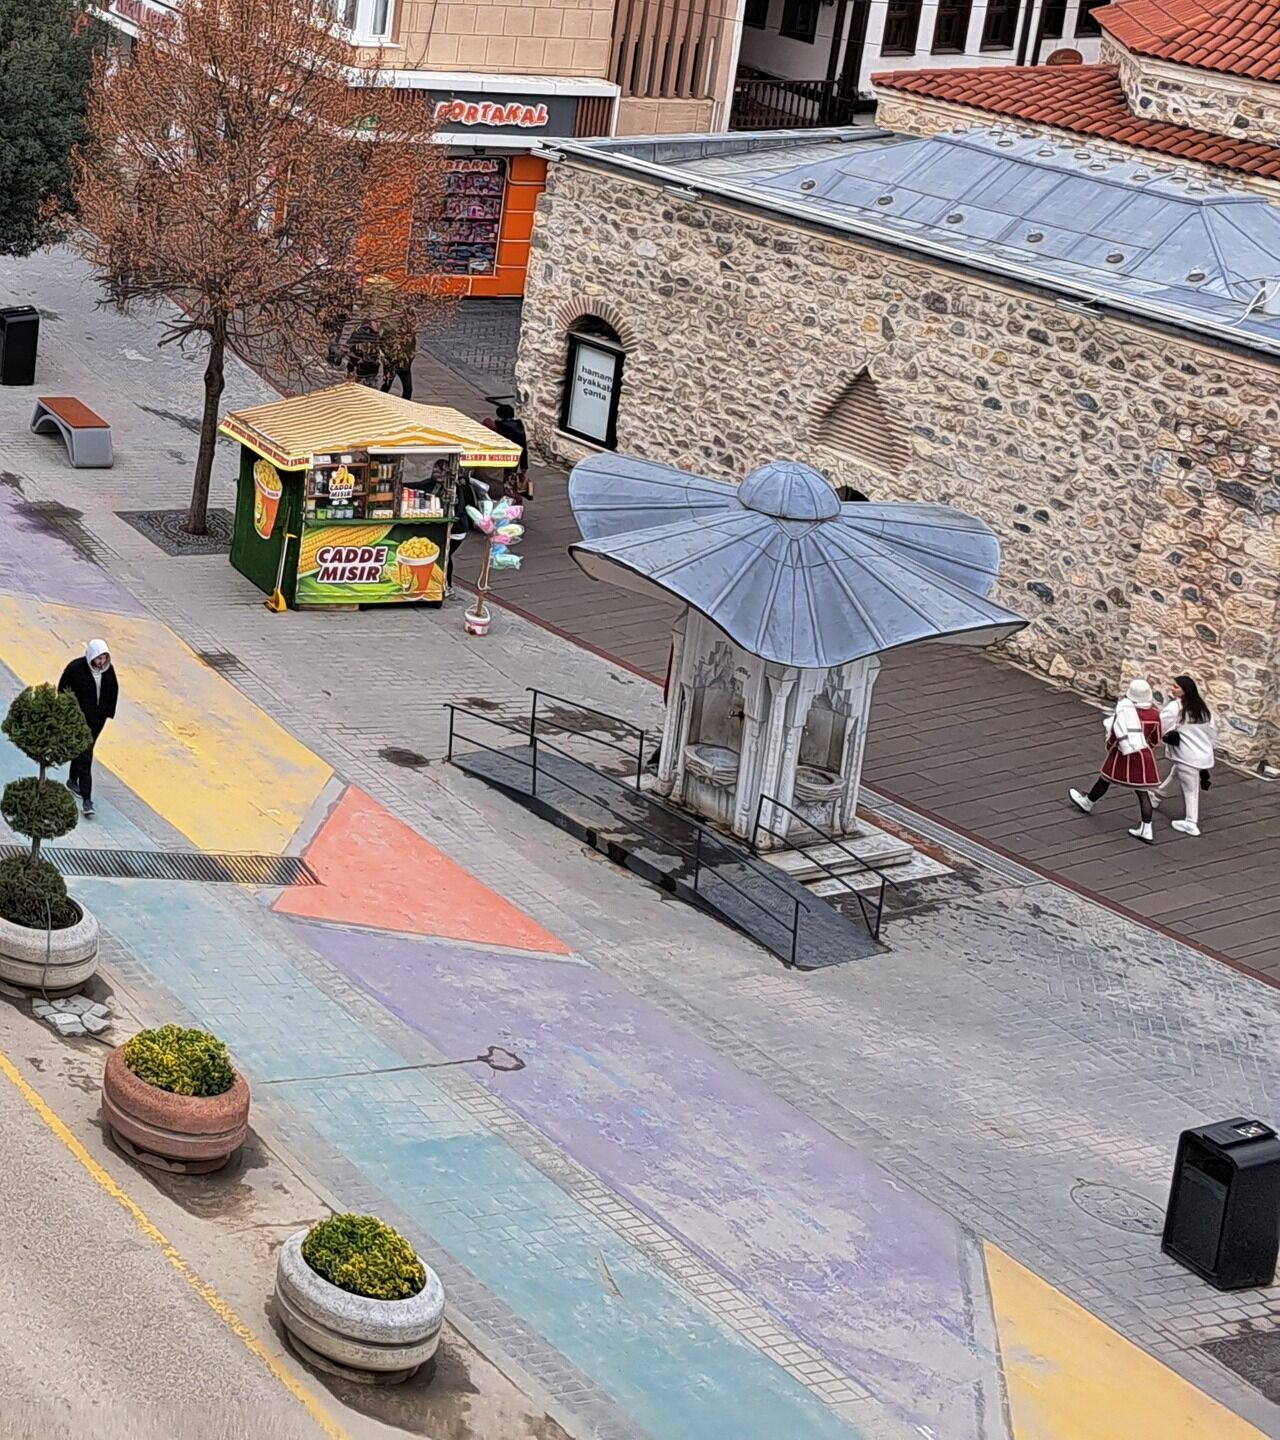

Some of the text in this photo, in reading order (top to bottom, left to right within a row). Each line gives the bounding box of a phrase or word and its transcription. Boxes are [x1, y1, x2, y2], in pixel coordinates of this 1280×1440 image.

[433, 101, 549, 128] PORTAKAL
[581, 365, 612, 383] hamam
[583, 387, 607, 401] çanta
[318, 548, 387, 564] CADDE
[319, 566, 381, 582] MISIR
